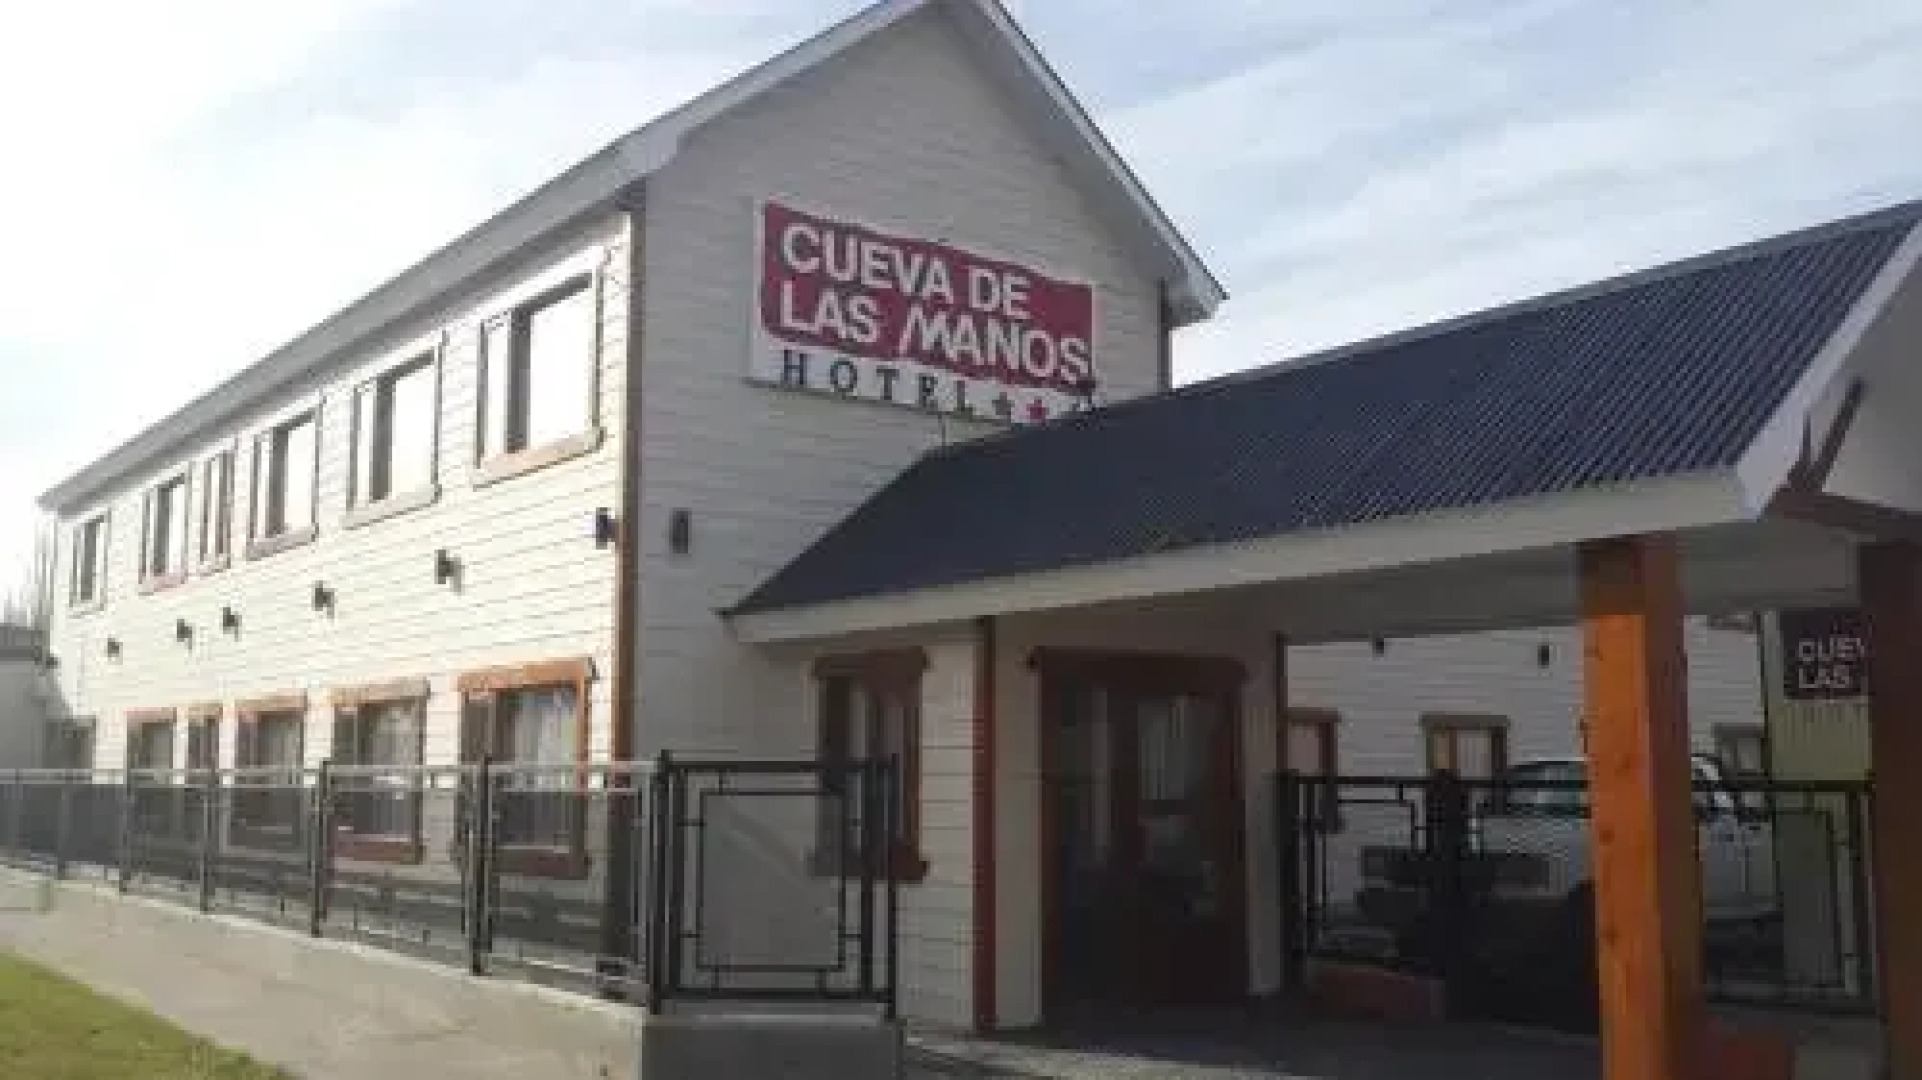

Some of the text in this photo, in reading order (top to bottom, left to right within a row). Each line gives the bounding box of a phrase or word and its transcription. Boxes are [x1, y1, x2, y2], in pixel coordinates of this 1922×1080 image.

[782, 223, 1032, 320] CUEVA DE
[779, 281, 1091, 386] LAS MANOS
[782, 350, 968, 412] HOTEL
[1799, 667, 1850, 689] LAS
